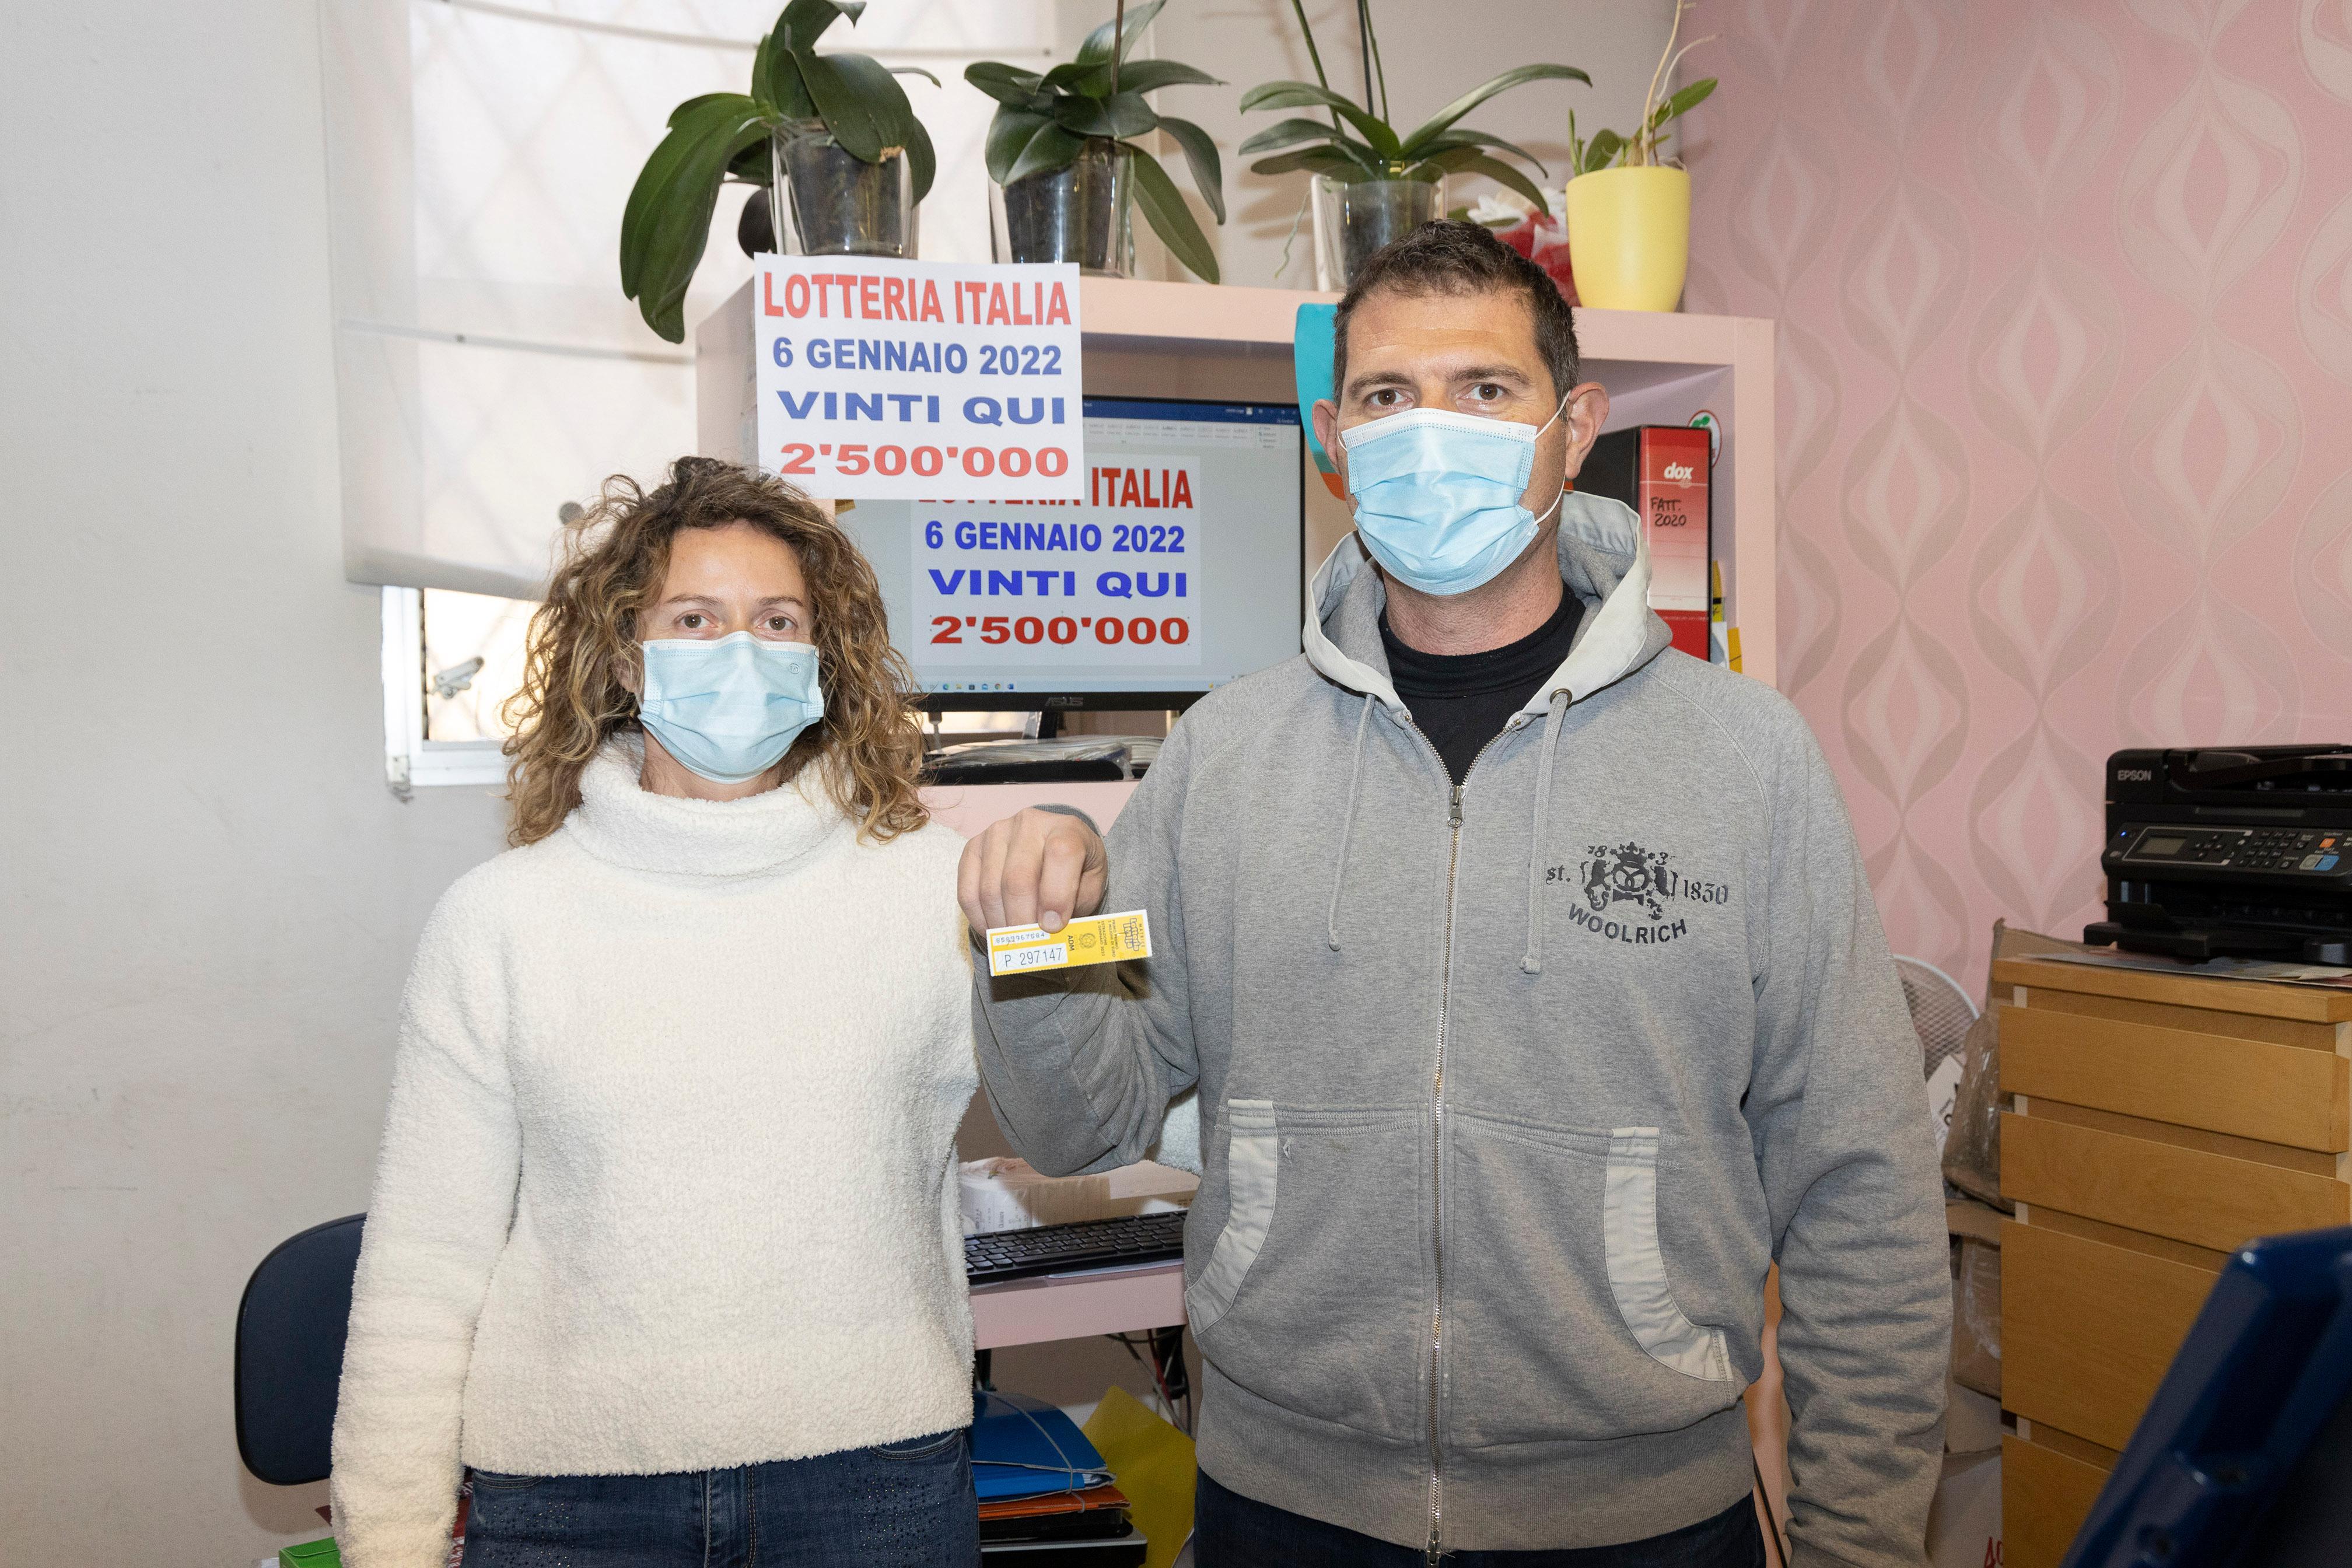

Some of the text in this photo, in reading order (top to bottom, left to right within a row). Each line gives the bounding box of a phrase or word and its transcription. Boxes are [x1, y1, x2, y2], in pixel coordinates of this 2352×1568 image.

[764, 272, 1072, 326] LOTTERIA ITALIA
[773, 337, 1062, 375] 6 GENNAIO 2022
[776, 390, 1065, 427] VINTI QUI
[780, 443, 1069, 477] 2'500'000
[1664, 462, 1693, 480] dox
[1091, 467, 1194, 509] ITALIA
[1654, 513, 1687, 527] 2020
[925, 521, 1185, 553] 6 GENNAIO 2022
[928, 569, 1187, 599] VINTI QUI
[930, 616, 1189, 645] 2'500'000
[1044, 696, 1084, 706] ASUS
[2118, 769, 2152, 781] EPSON
[1568, 902, 1688, 944] WOOLRICH
[1005, 947, 1062, 967] P 297147
[1067, 935, 1075, 951] ADM
